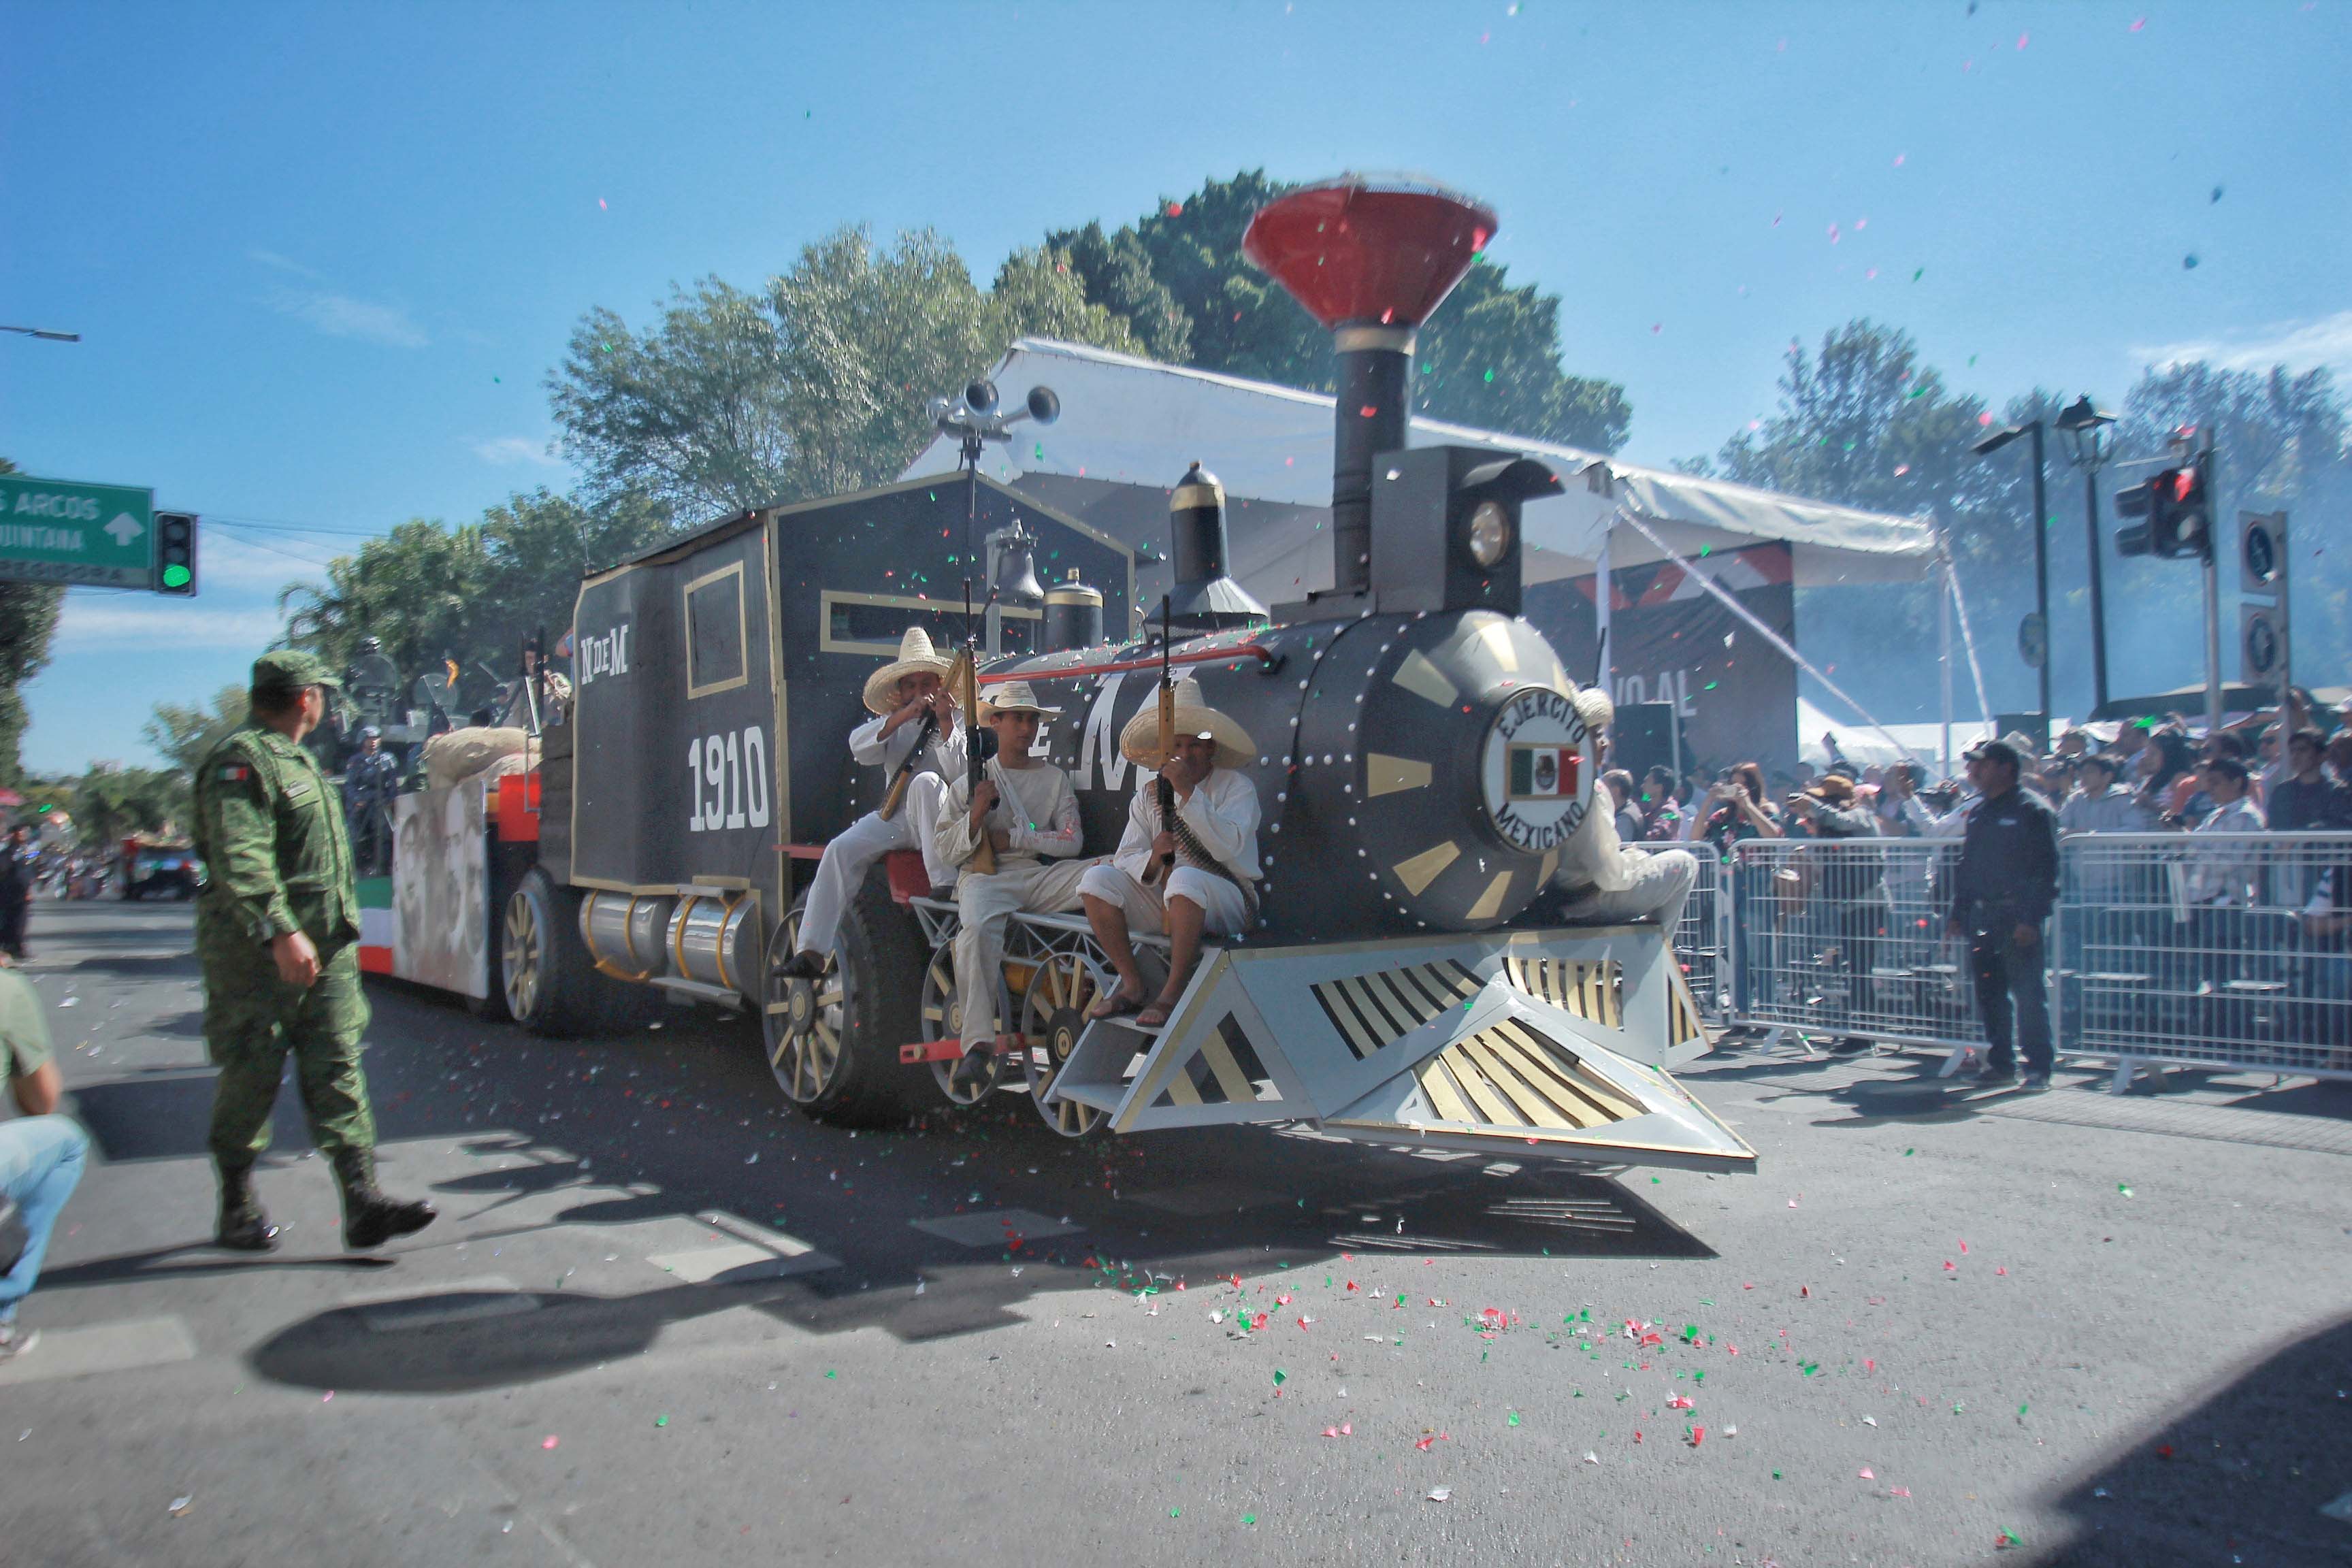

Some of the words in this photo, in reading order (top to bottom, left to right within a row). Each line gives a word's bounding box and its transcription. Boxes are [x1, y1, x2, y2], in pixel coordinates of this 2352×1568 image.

[14, 492, 101, 520] ARCOS
[0, 525, 84, 552] UINTANA
[1498, 693, 1588, 743] EJERCITO
[689, 725, 769, 832] 1910
[1495, 802, 1584, 851] MEXICANO
